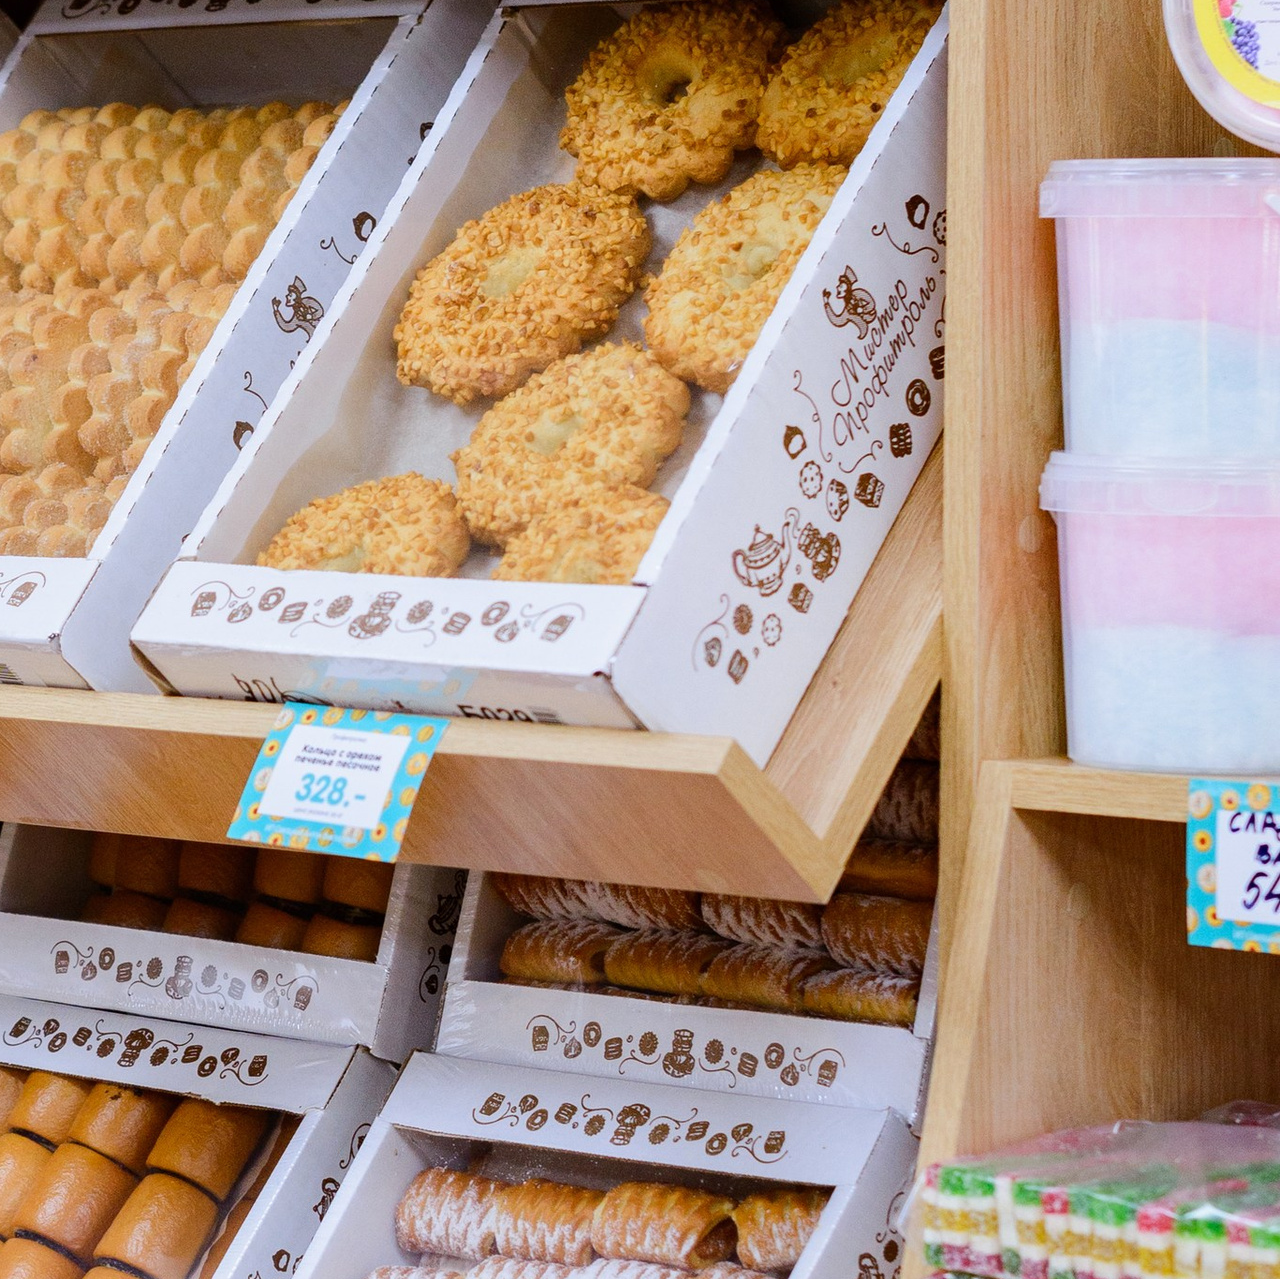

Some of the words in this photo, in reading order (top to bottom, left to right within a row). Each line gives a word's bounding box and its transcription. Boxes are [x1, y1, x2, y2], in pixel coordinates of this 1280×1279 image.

[831, 277, 909, 409] Мистер
[833, 275, 937, 447] Профитроль
[1230, 812, 1280, 842] СЛА
